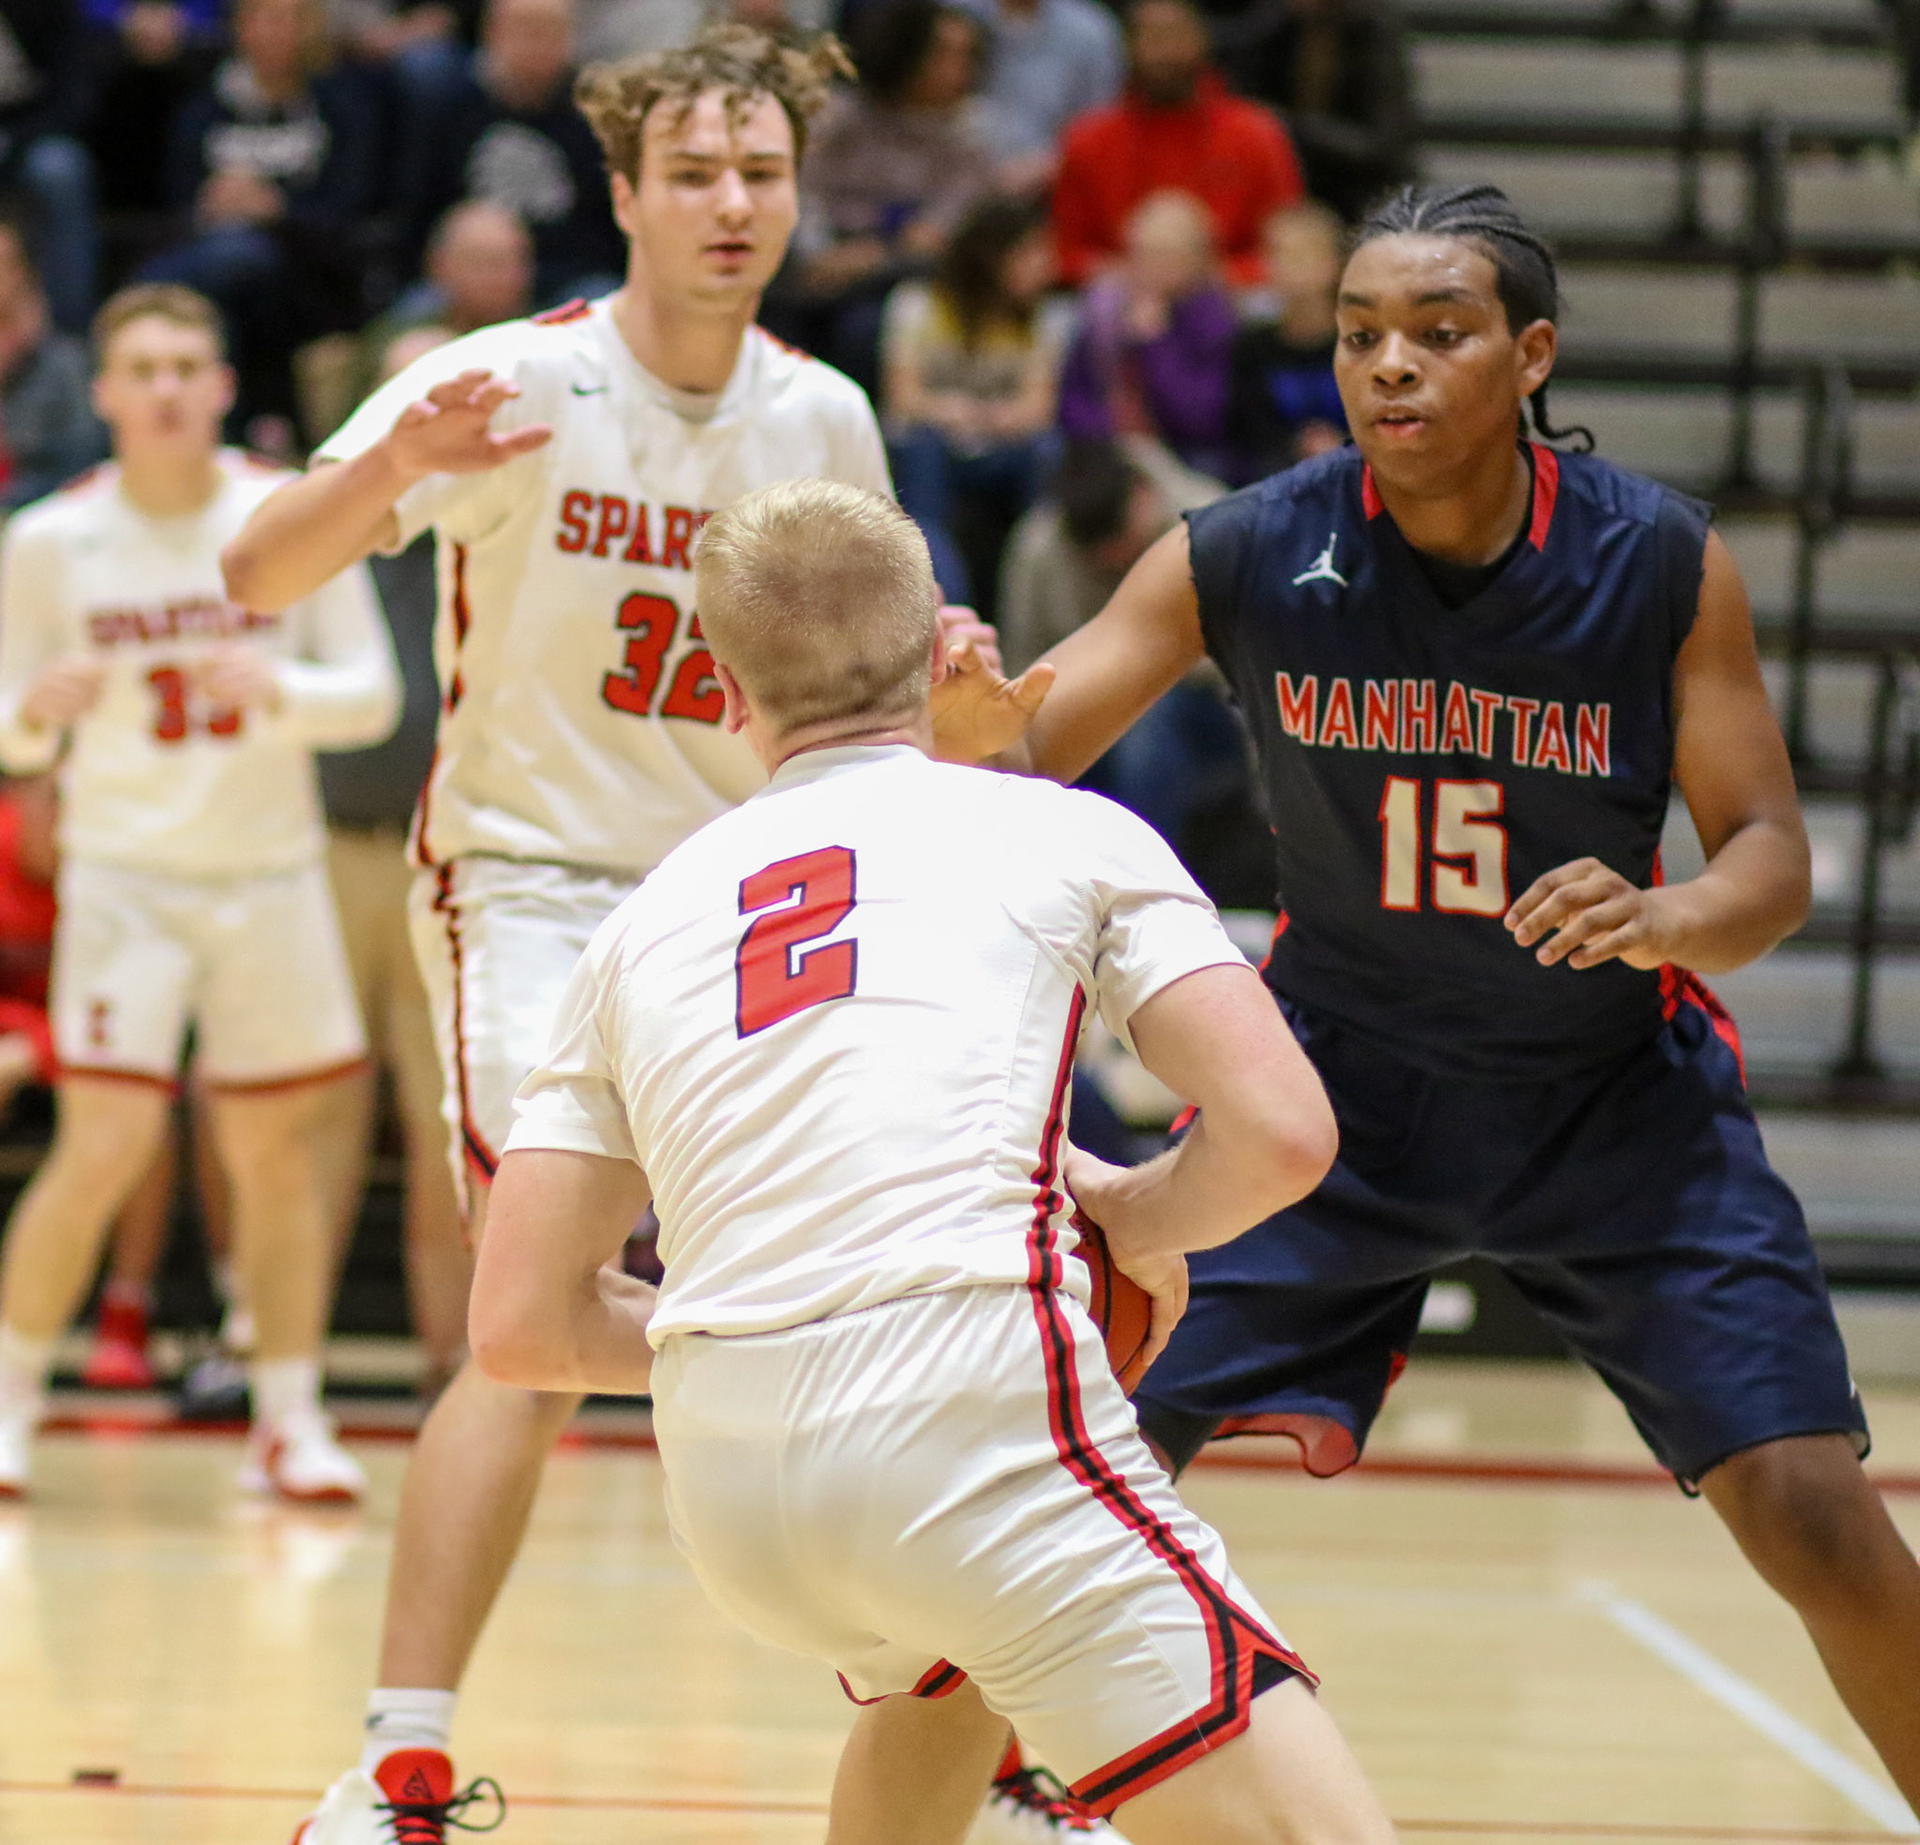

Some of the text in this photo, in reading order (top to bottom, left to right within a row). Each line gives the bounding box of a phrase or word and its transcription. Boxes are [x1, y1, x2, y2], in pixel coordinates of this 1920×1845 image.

[601, 591, 725, 724] 32
[1275, 671, 1612, 778] MANHATTAN
[1379, 774, 1511, 918] 15
[735, 845, 858, 1040] 2
